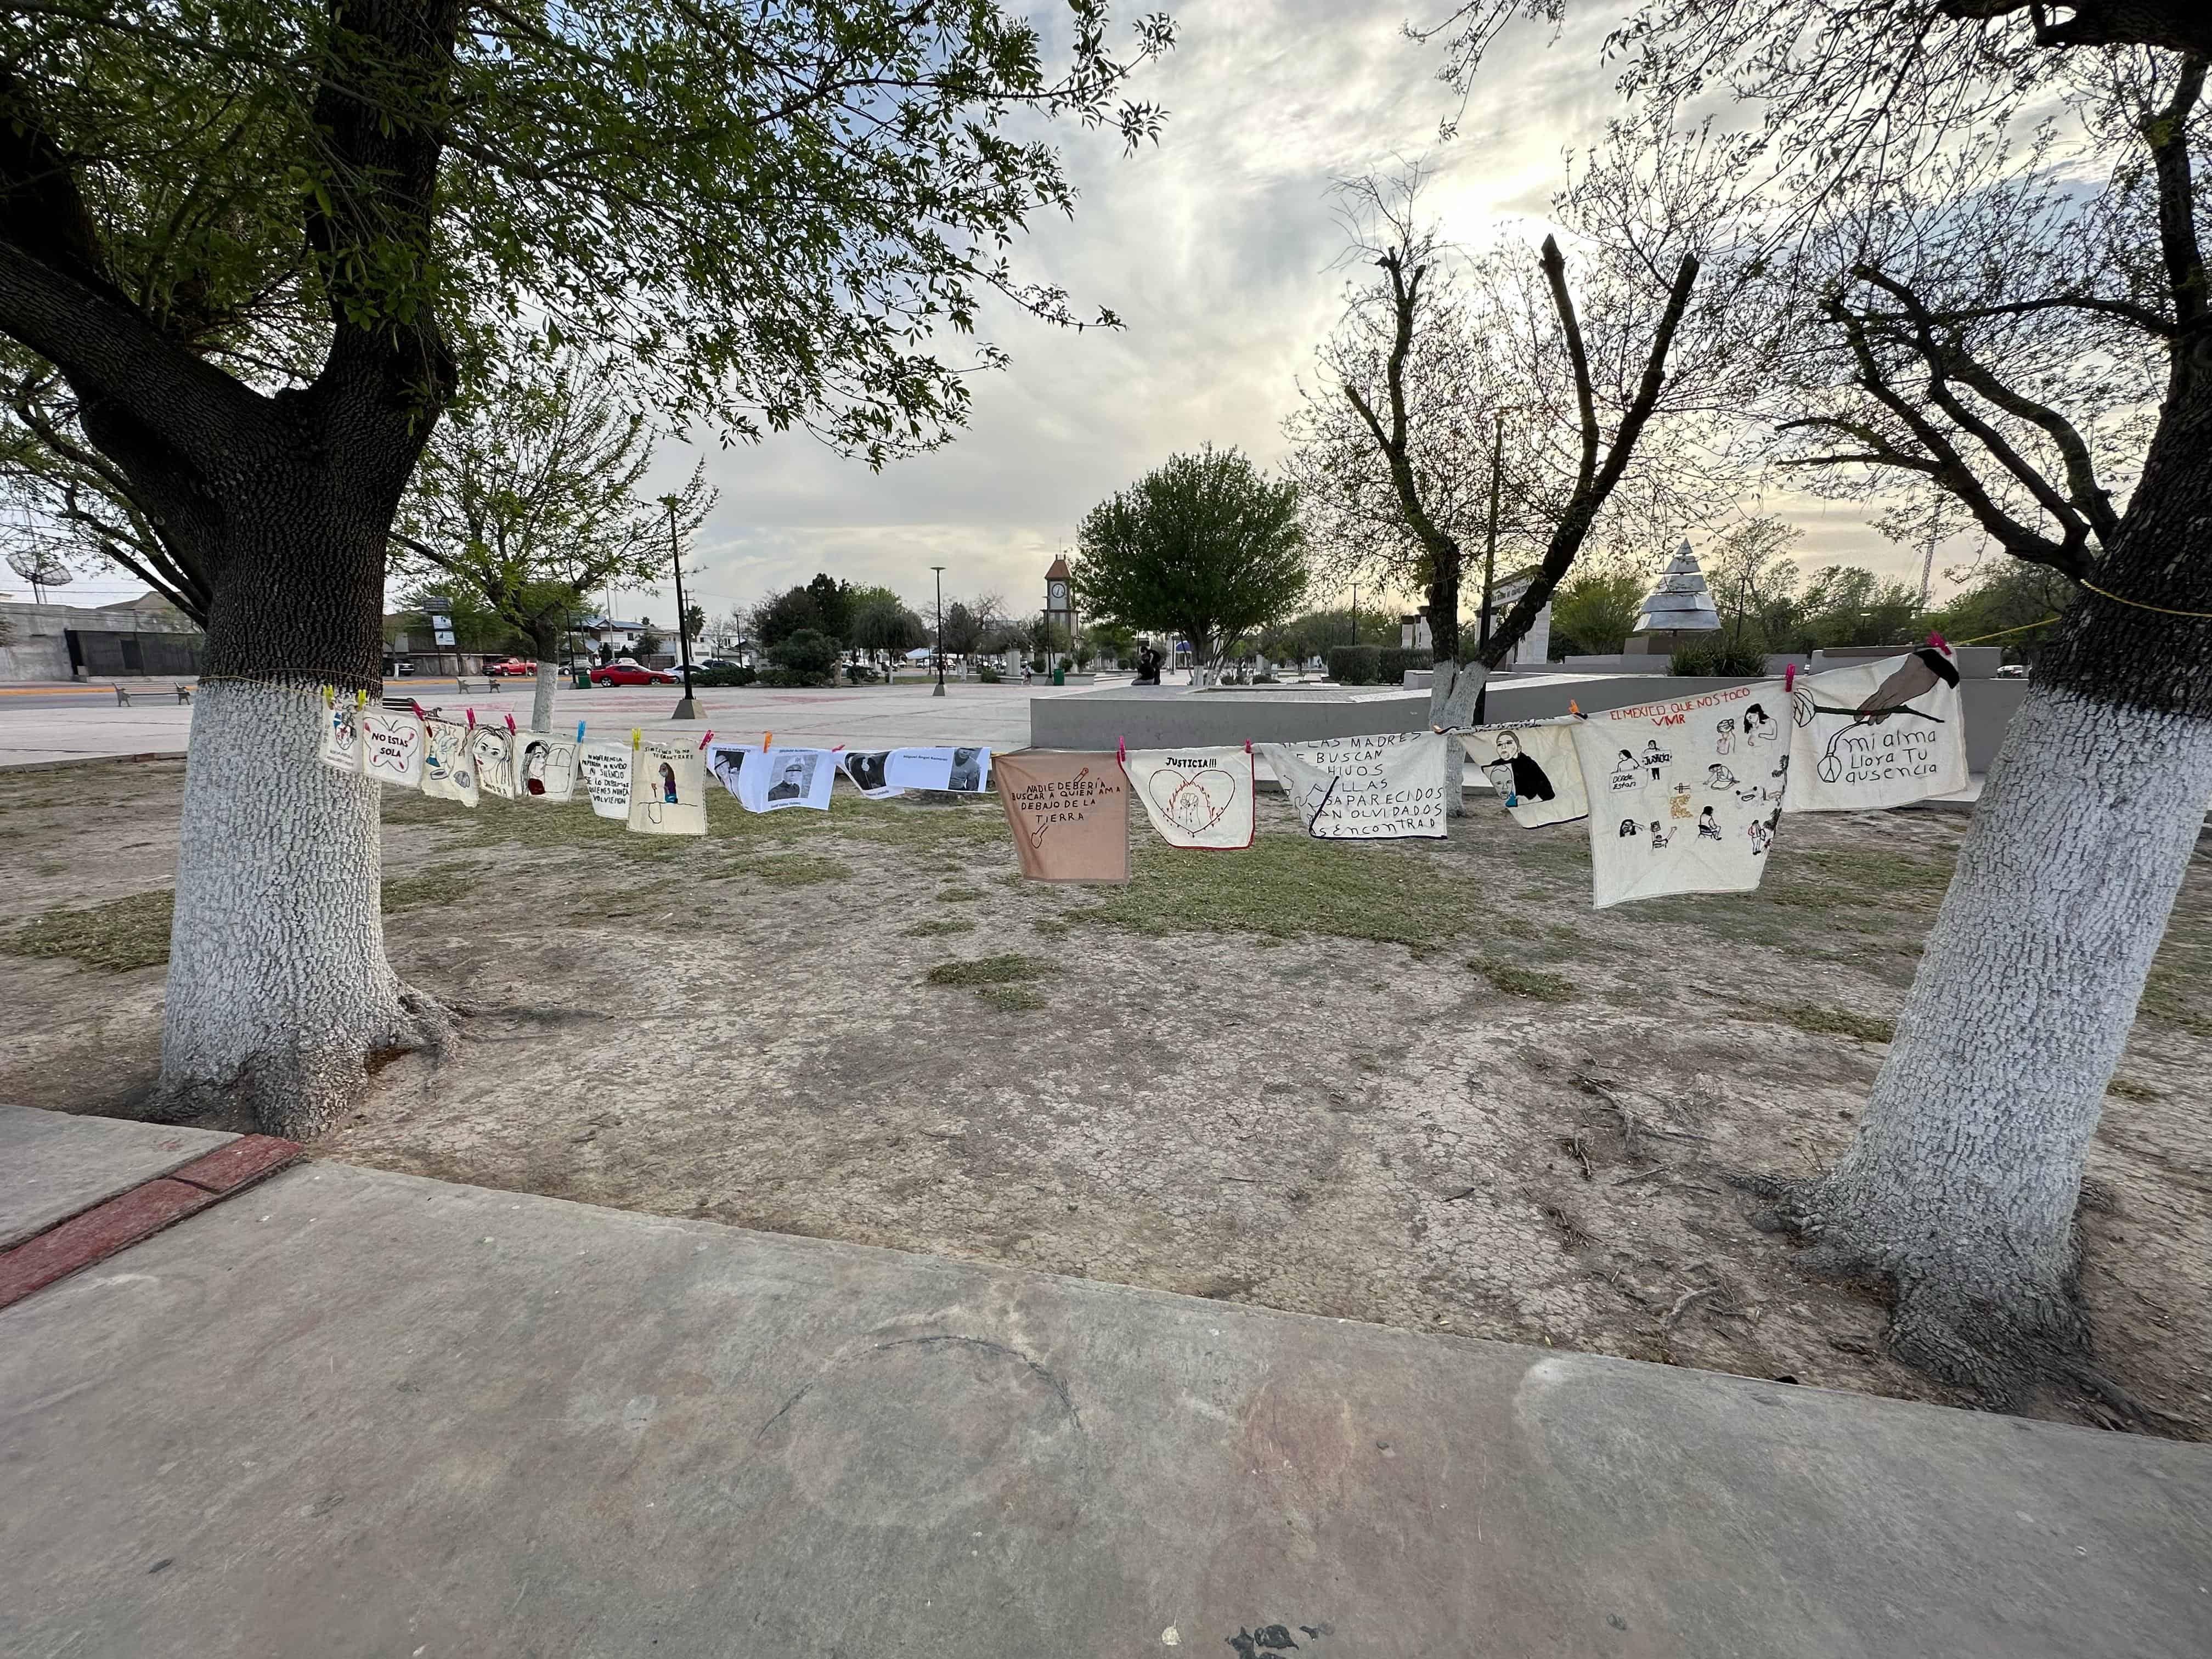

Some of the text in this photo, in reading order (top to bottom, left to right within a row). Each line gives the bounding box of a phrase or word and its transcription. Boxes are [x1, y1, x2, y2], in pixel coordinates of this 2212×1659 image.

[1610, 710, 1622, 720] EL
[1623, 706, 1666, 719] MEXICO
[1671, 701, 1695, 713] QUE
[1696, 693, 1720, 708] NOS
[1651, 714, 1686, 726] VIVIR
[372, 732, 408, 748] NO ESTAS
[1351, 731, 1421, 748] MADRES
[1883, 729, 1936, 747] alma
[380, 747, 402, 758] SOLA
[1316, 750, 1383, 764] BUSCAN
[1846, 764, 1937, 786] ausencia
[1026, 783, 1054, 794] NADIE
[1011, 792, 1045, 801] BUSCAR
[1022, 800, 1060, 810] DEBAJO
[1064, 800, 1078, 808] DE
[1351, 803, 1442, 819] OLVIDADOS
[1036, 812, 1084, 823] TIERRA
